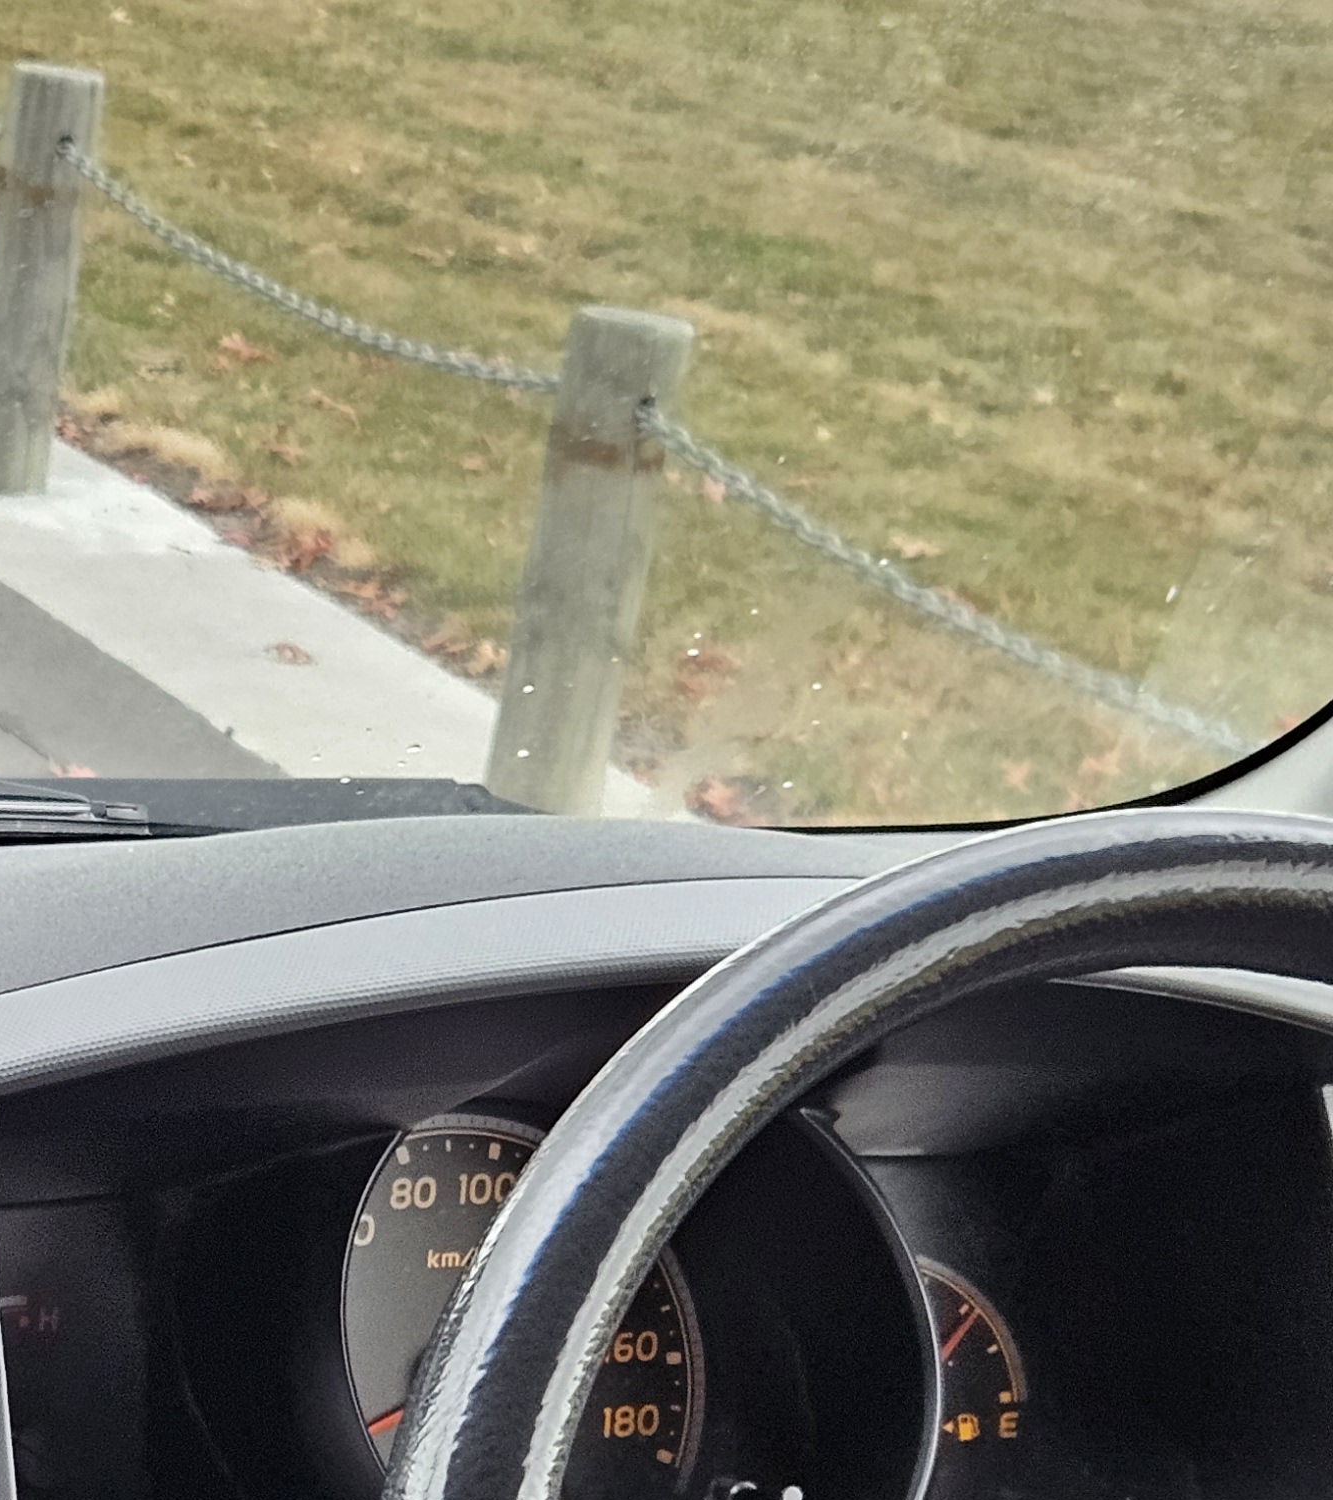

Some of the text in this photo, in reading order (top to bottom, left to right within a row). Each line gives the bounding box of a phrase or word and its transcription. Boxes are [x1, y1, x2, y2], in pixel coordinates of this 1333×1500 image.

[390, 1177, 437, 1210] 80
[427, 1247, 476, 1269] km/
[603, 1404, 660, 1438] 180
[999, 1411, 1018, 1439] E
